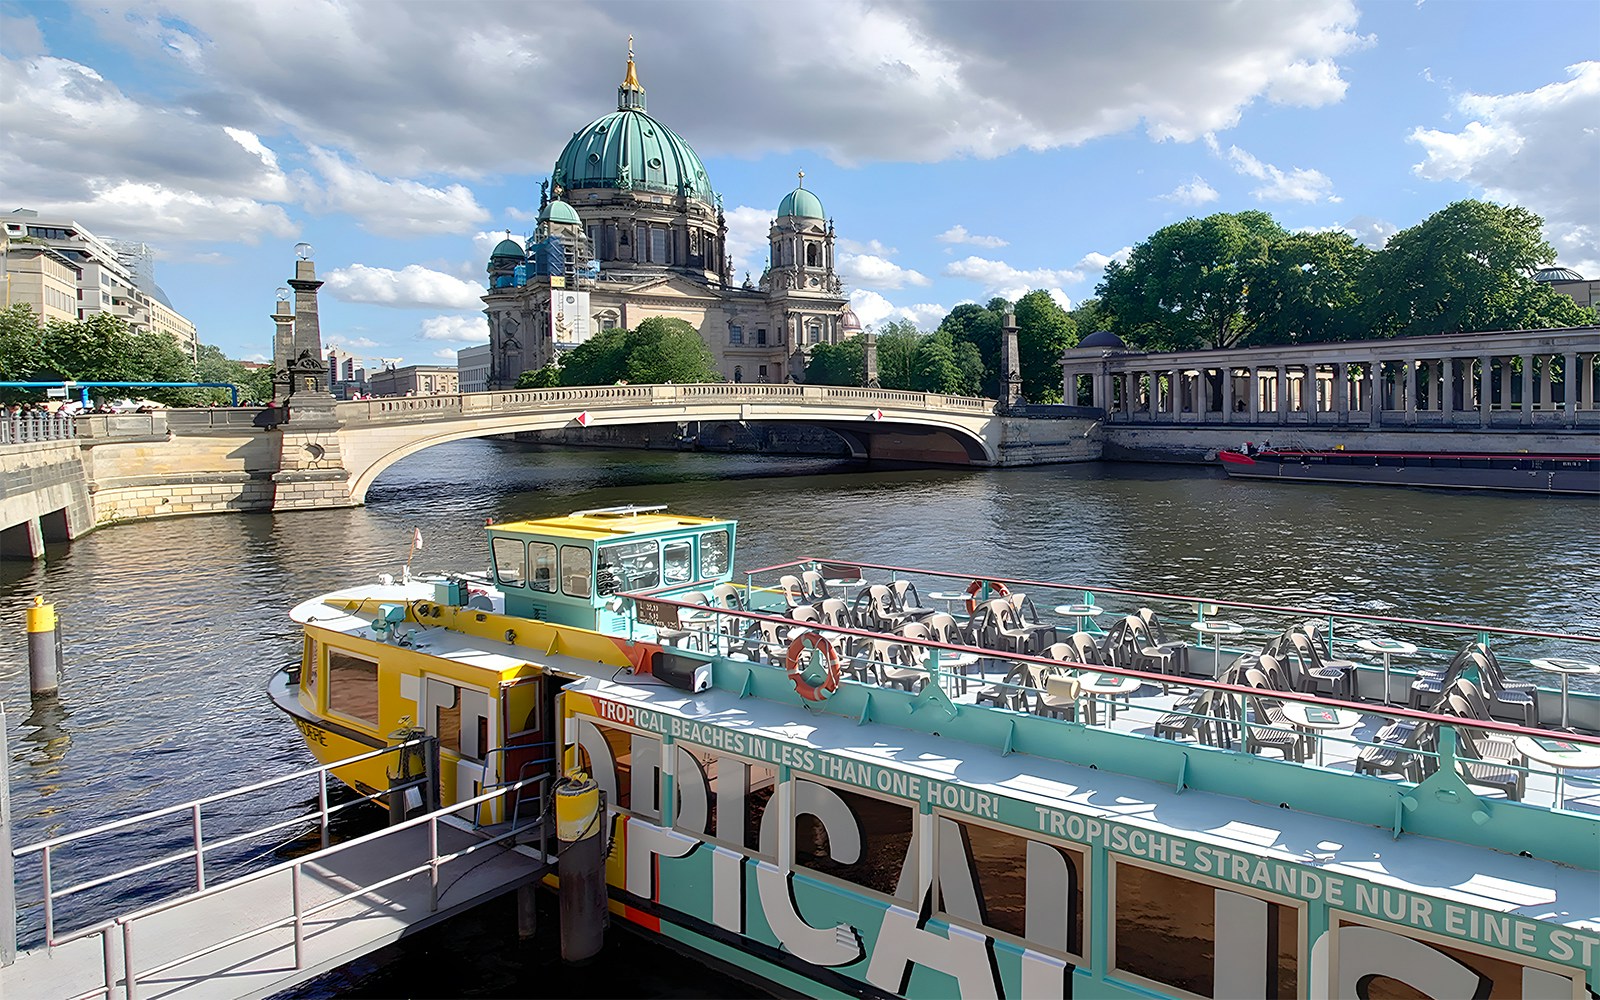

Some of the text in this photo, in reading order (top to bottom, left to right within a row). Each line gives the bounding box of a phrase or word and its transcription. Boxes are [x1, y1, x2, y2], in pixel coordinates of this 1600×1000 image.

[600, 700, 1000, 819] TROPICAL BEACHES IN LESS THAN ONE HOUR!
[1035, 807, 1187, 866] TROPISCHE
[1194, 846, 1344, 906] STRÄNDE
[1355, 884, 1433, 928] NUR
[1445, 904, 1537, 953] EINE
